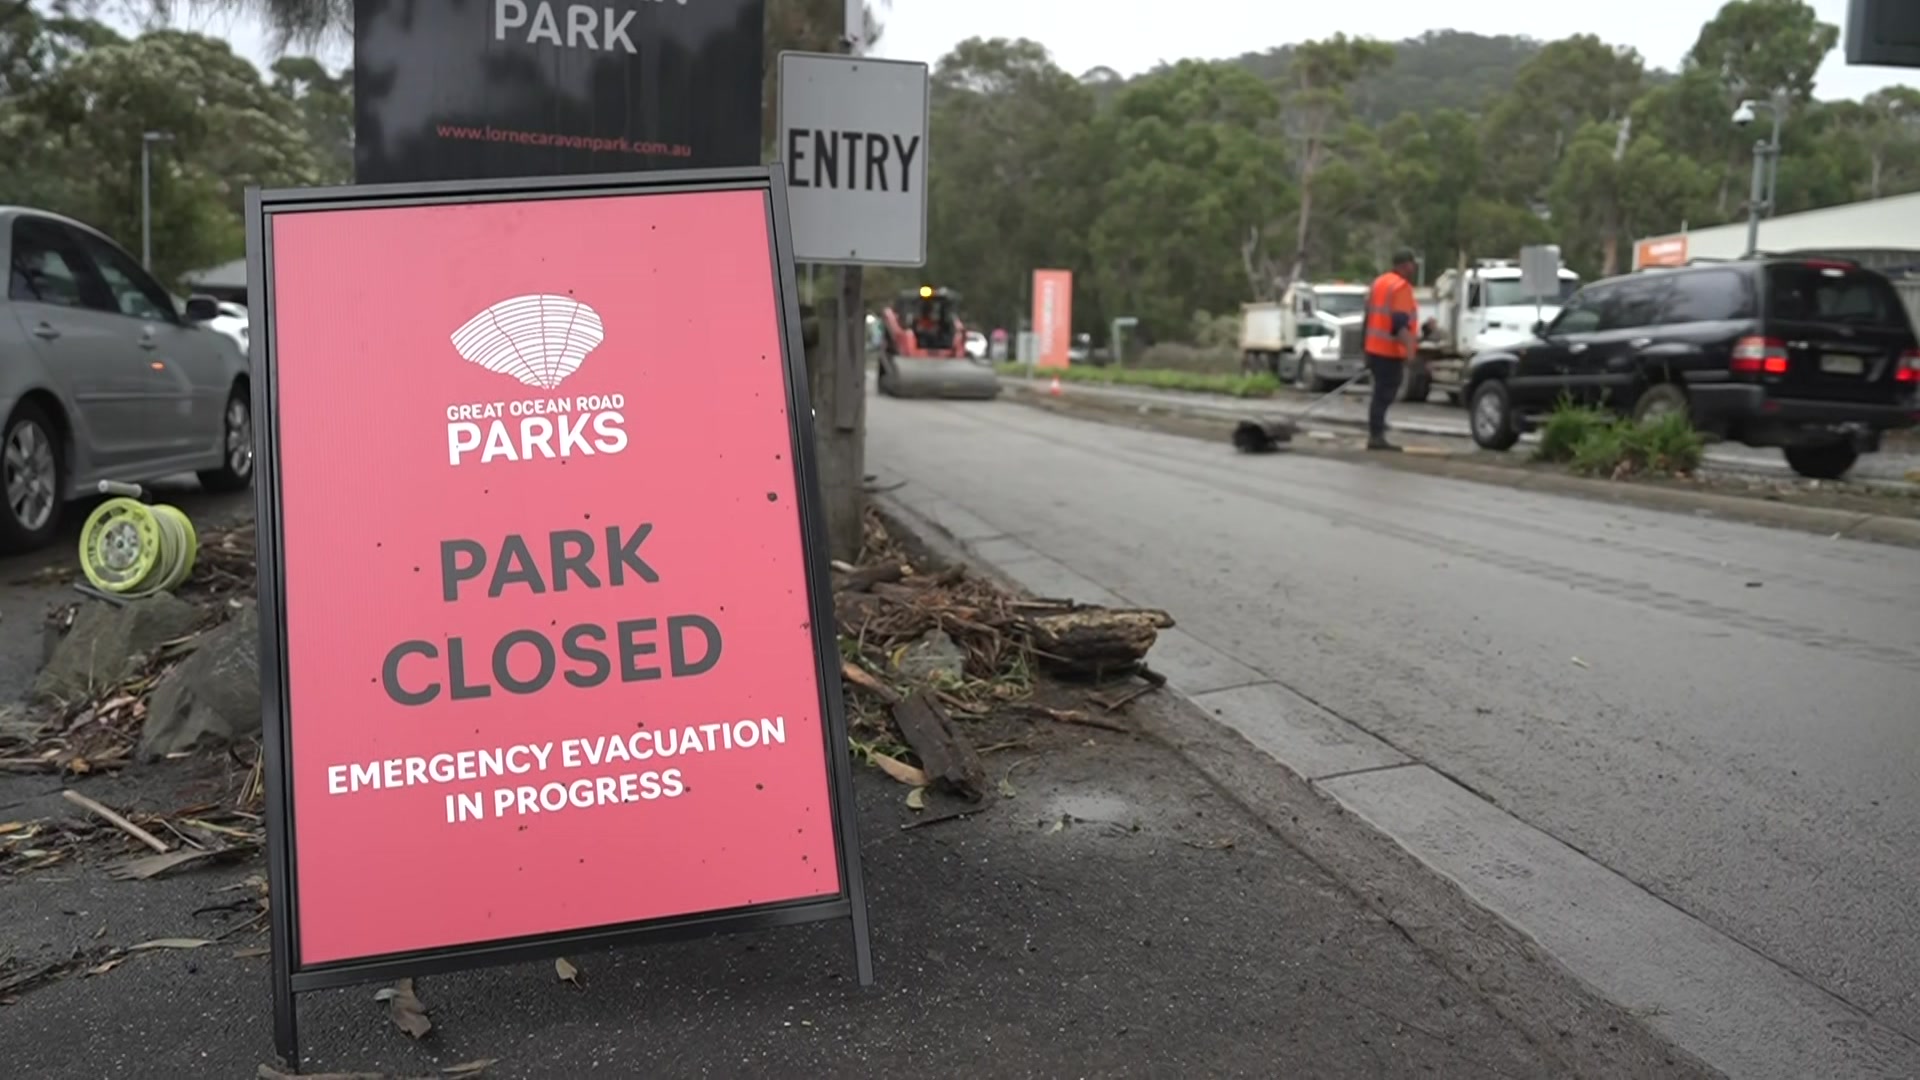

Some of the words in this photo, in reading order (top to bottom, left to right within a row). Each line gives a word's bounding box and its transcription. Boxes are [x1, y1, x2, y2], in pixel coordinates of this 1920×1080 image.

[495, 0, 637, 53] PARK
[436, 124, 692, 157] www.lornecaravanpark.com.au
[788, 128, 921, 193] ENTRY
[446, 402, 505, 421] GREAT
[509, 397, 571, 416] OCEAN
[576, 393, 625, 411] ROAD
[447, 411, 628, 466] PARKS
[441, 523, 660, 602] PARK
[382, 614, 723, 706] CLOSED
[328, 742, 553, 795] EMERGENCY
[561, 717, 786, 767] EVACUATION
[446, 792, 484, 823] IN
[494, 768, 684, 817] PROGRESS
